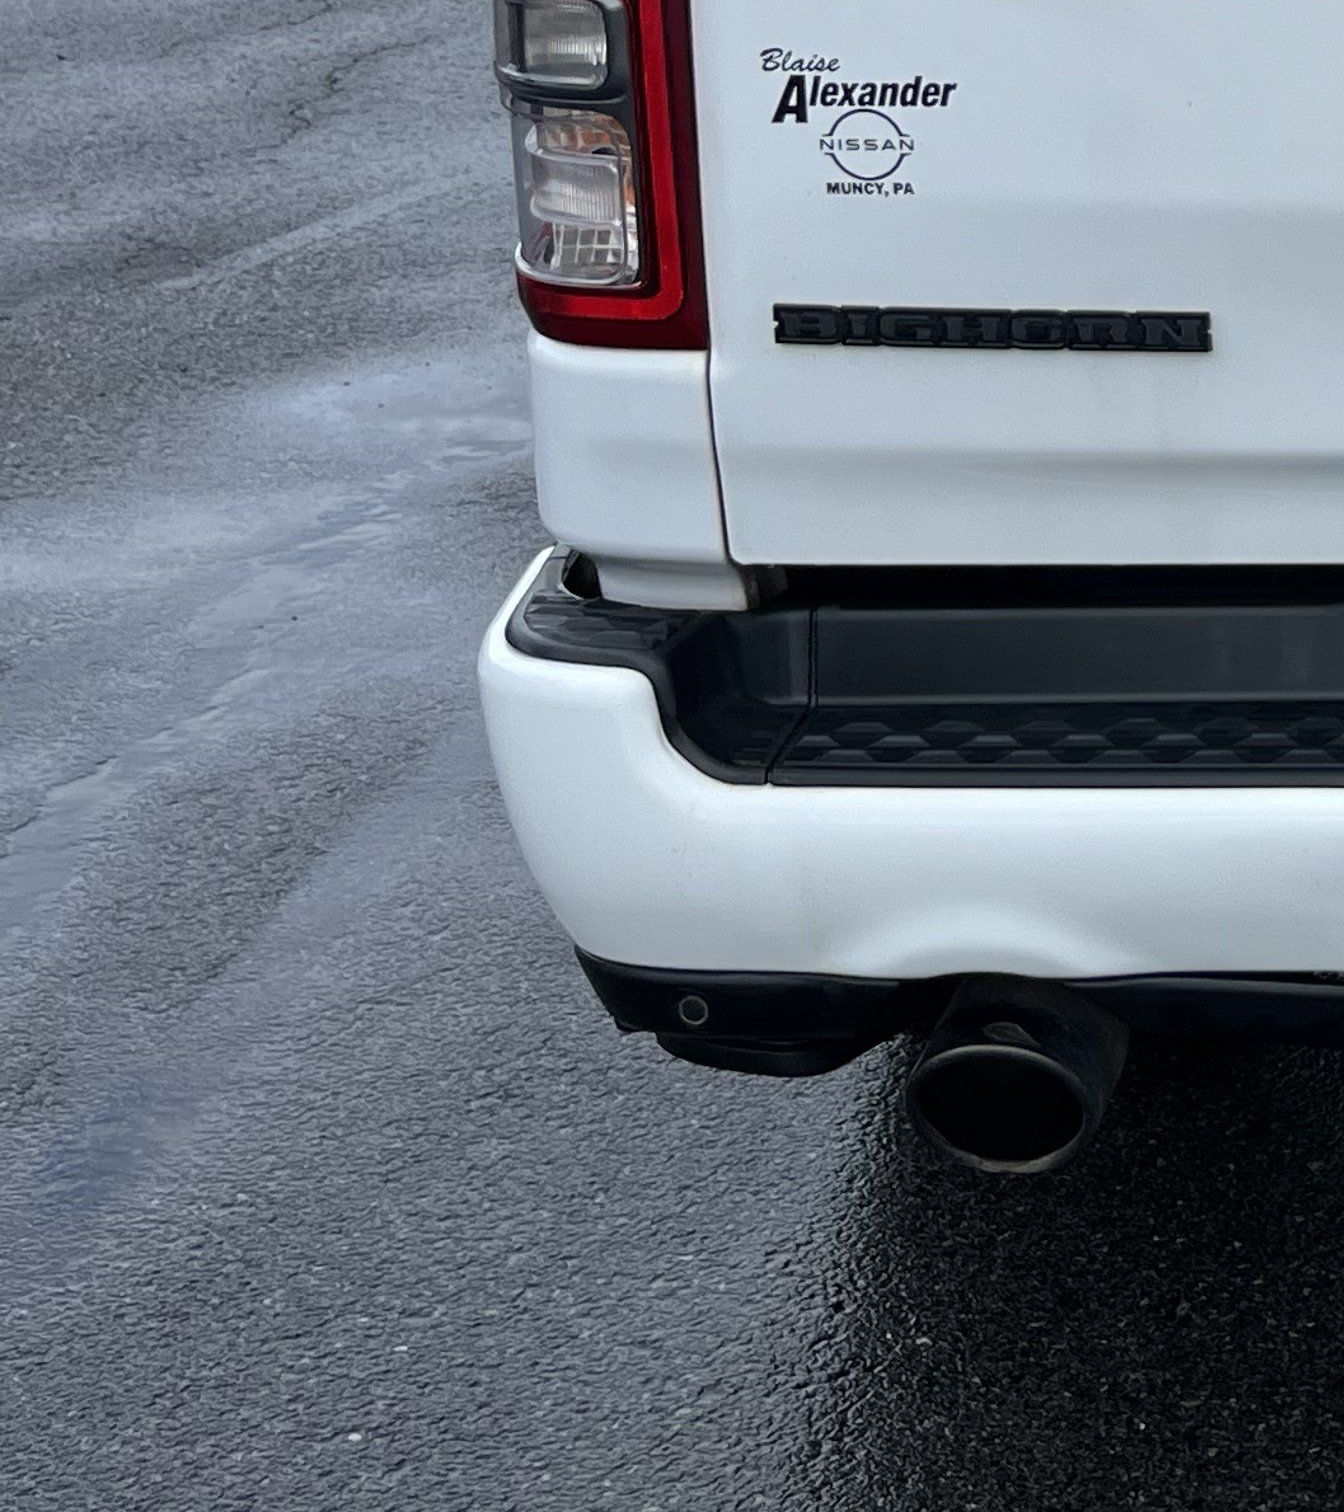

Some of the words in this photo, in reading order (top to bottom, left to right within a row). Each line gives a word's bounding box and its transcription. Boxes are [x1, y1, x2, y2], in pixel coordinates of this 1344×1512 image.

[760, 47, 841, 72] Blaise
[771, 74, 957, 123] Alexander
[819, 138, 915, 151] NISSAN
[826, 182, 889, 197] MUNCY,
[893, 182, 915, 195] PA
